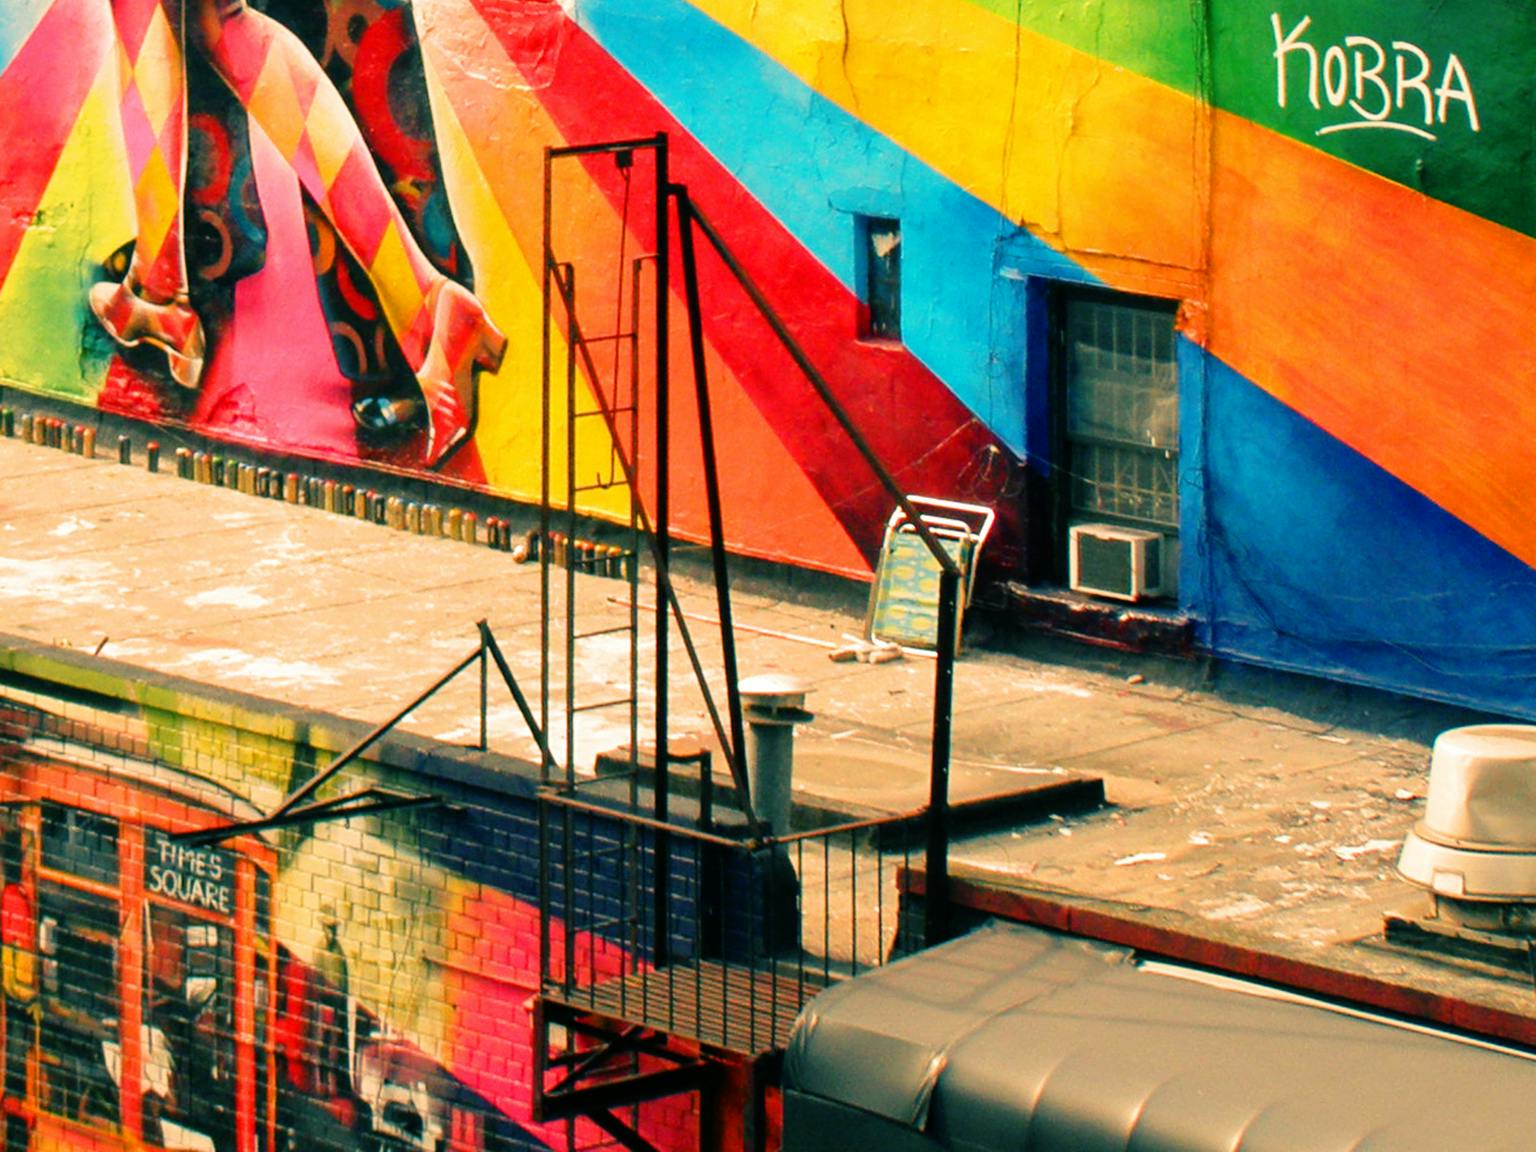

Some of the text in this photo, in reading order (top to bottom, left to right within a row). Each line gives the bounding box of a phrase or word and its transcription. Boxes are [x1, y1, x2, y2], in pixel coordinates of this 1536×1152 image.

[1269, 11, 1481, 133] KOBRA
[155, 838, 222, 881] TIMES
[150, 865, 231, 914] SQUARE
